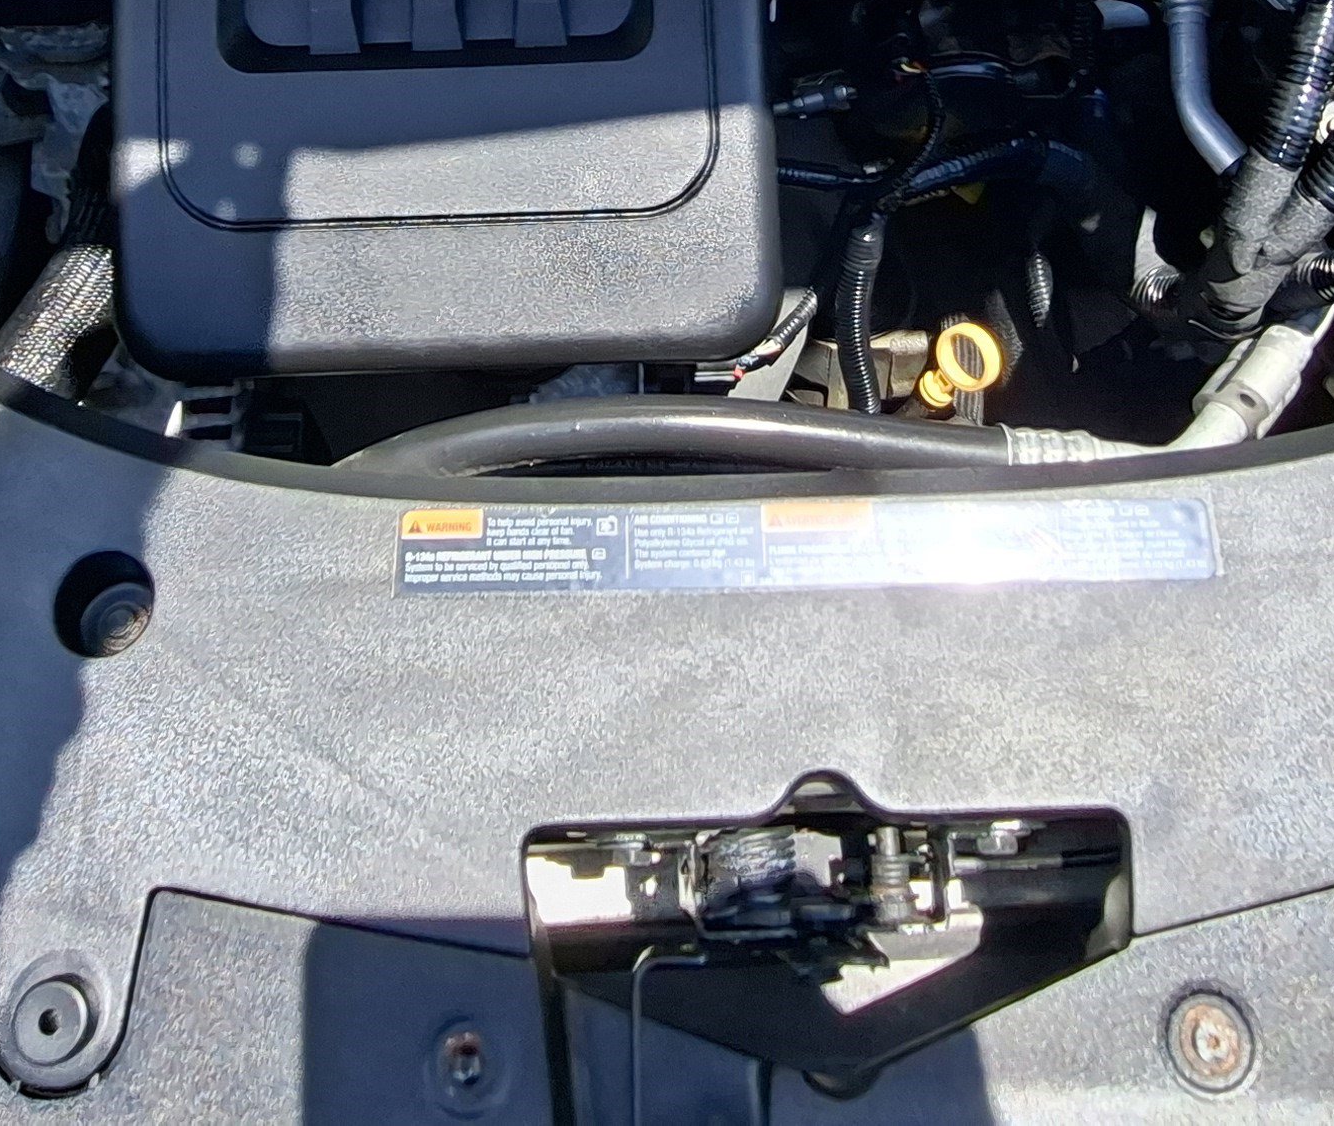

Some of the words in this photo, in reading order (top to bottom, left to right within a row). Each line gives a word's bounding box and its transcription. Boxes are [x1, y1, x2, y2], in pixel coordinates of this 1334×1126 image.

[487, 518, 496, 527] To
[498, 518, 513, 528] help
[537, 517, 569, 530] personal
[650, 514, 707, 524] CONDITIONING
[426, 522, 472, 532] WARNING
